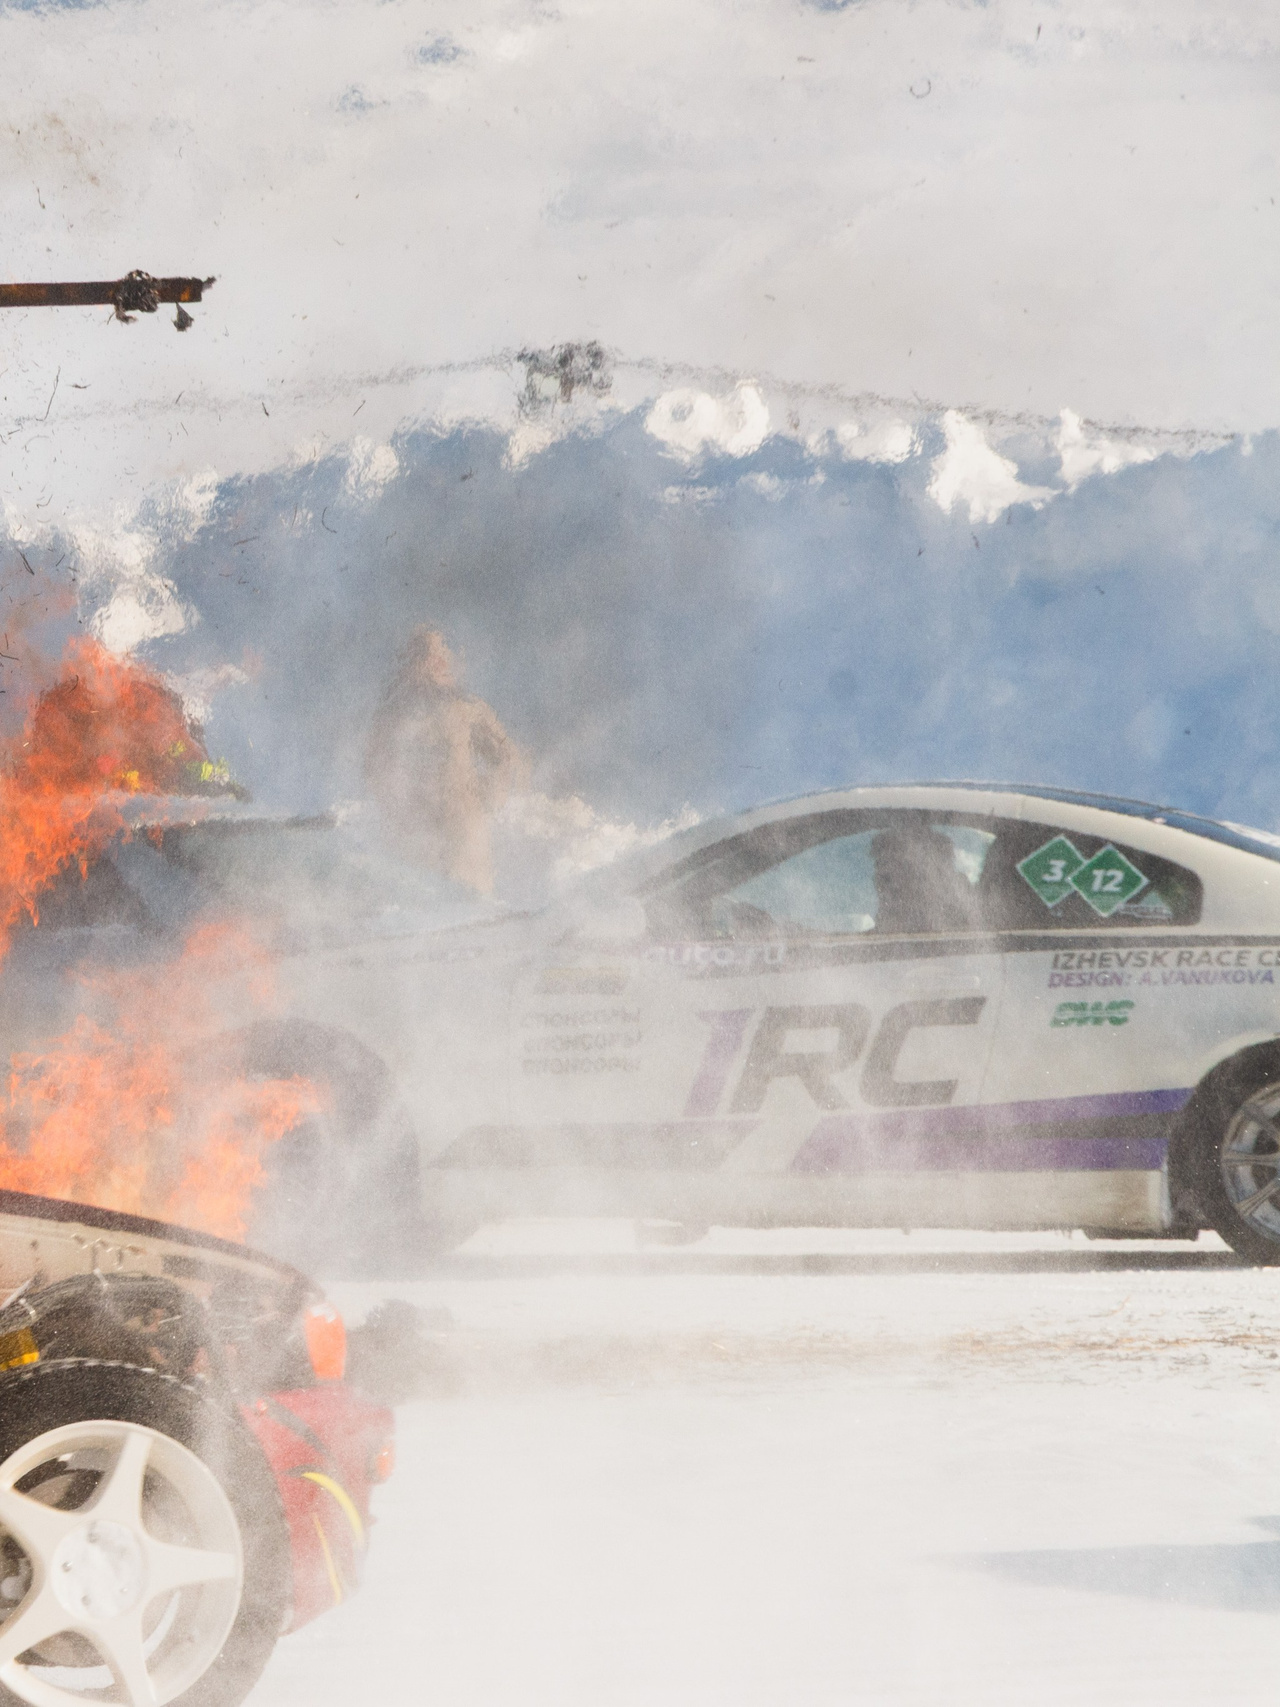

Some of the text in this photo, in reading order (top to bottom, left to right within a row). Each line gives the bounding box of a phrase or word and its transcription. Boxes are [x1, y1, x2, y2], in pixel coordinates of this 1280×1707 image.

[1091, 869, 1124, 892] 12
[1051, 950, 1168, 970] IZHEVSK
[1176, 950, 1251, 968] RACE
